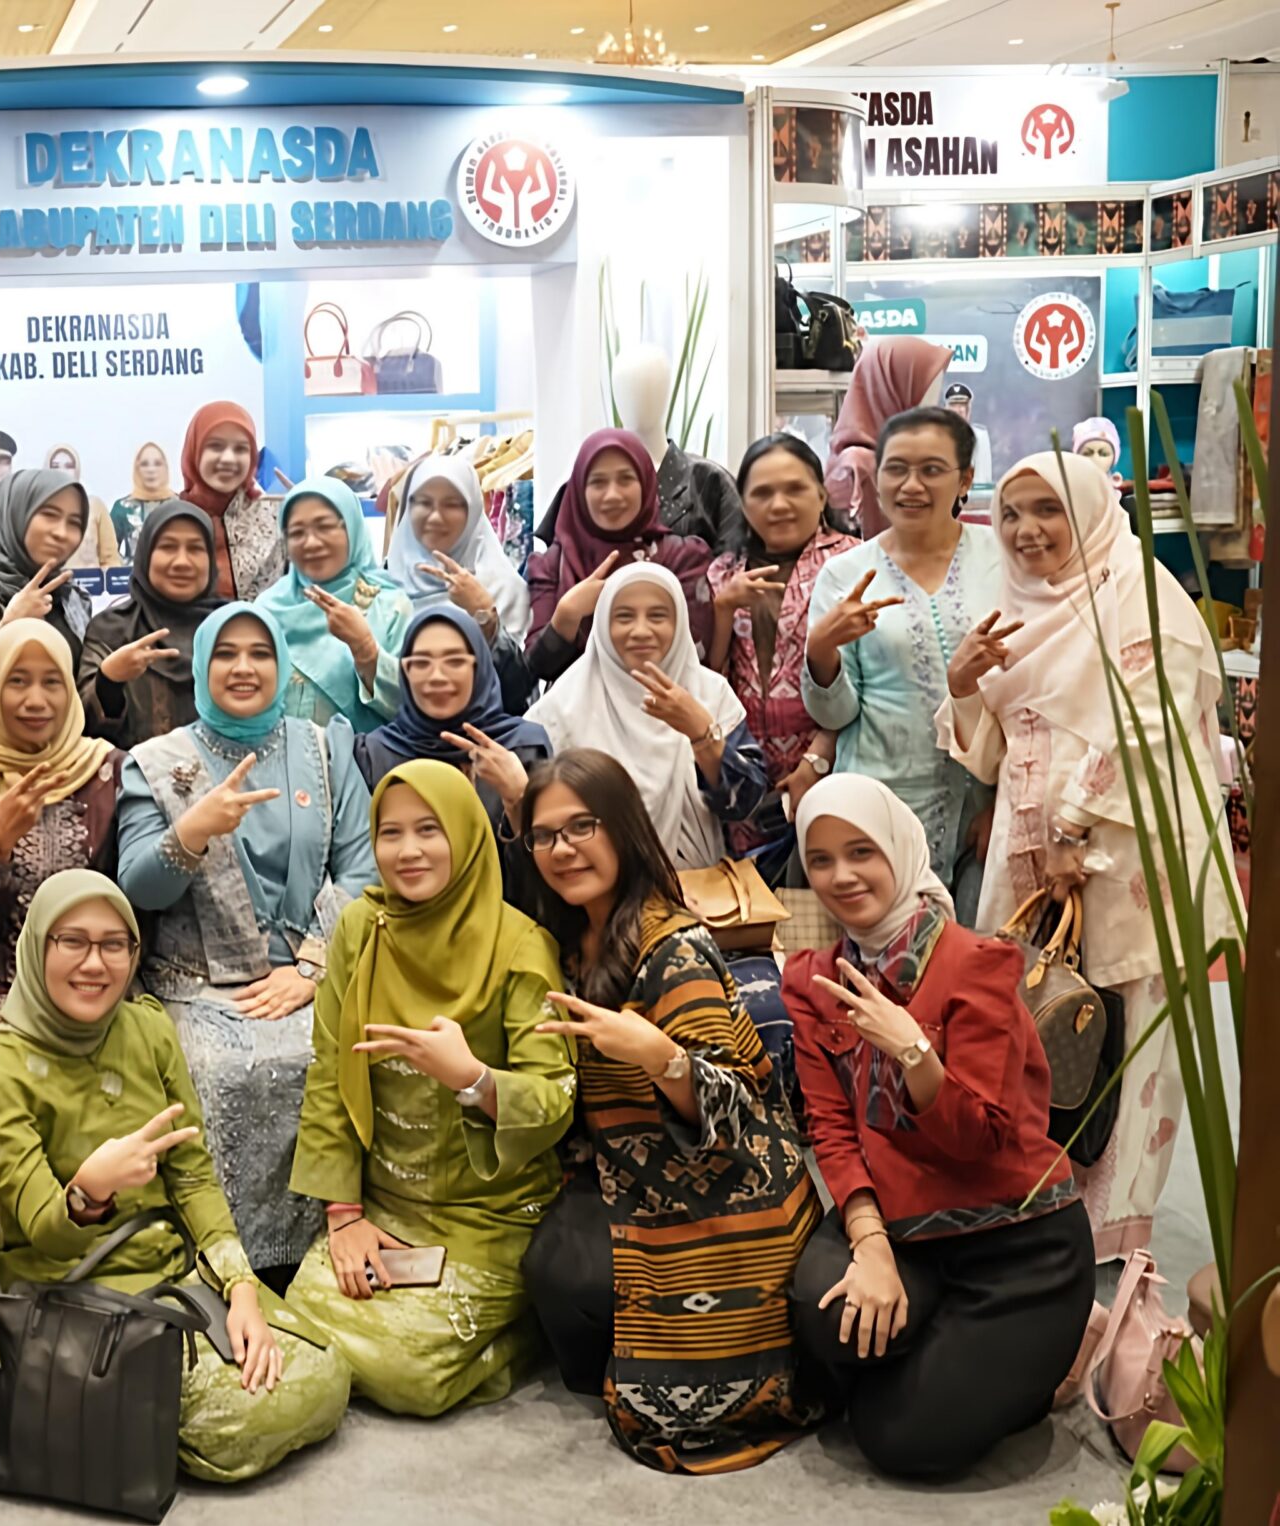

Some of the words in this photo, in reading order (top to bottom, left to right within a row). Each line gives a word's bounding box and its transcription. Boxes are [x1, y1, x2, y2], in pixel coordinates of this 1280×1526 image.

[851, 91, 934, 126] ASDA
[24, 125, 381, 184] DEKRANASDA
[886, 136, 998, 177] ASAHAN
[200, 202, 277, 251] DELI
[290, 198, 454, 250] SERDANG
[26, 312, 171, 344] DEKRANASDA
[52, 350, 98, 379] DELI
[105, 347, 204, 377] SERDANG
[948, 344, 979, 362] AN
